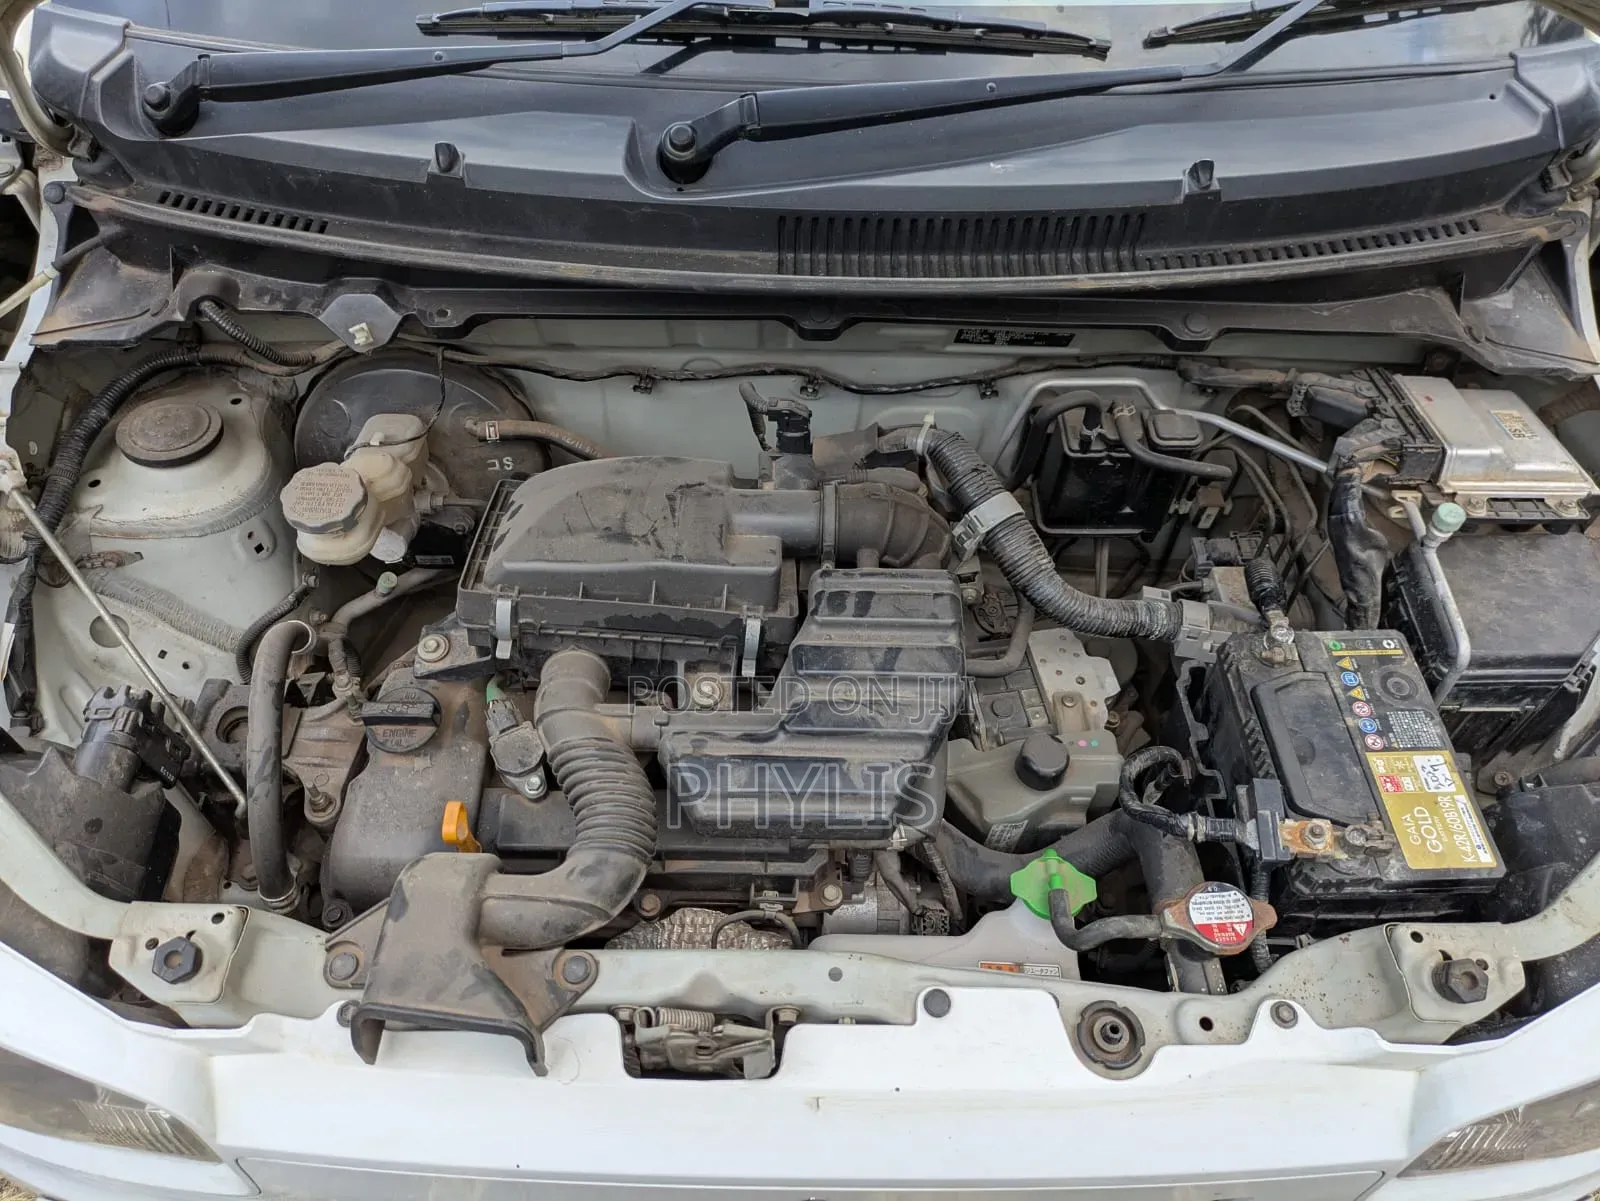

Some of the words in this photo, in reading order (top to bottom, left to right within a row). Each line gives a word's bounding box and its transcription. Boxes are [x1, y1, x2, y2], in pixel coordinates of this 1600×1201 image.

[382, 728, 418, 738] ENGINE
[1402, 813, 1422, 845] GAIA
[1413, 806, 1443, 853] GOLD
[1437, 795, 1477, 863] K-42R/60B19R
